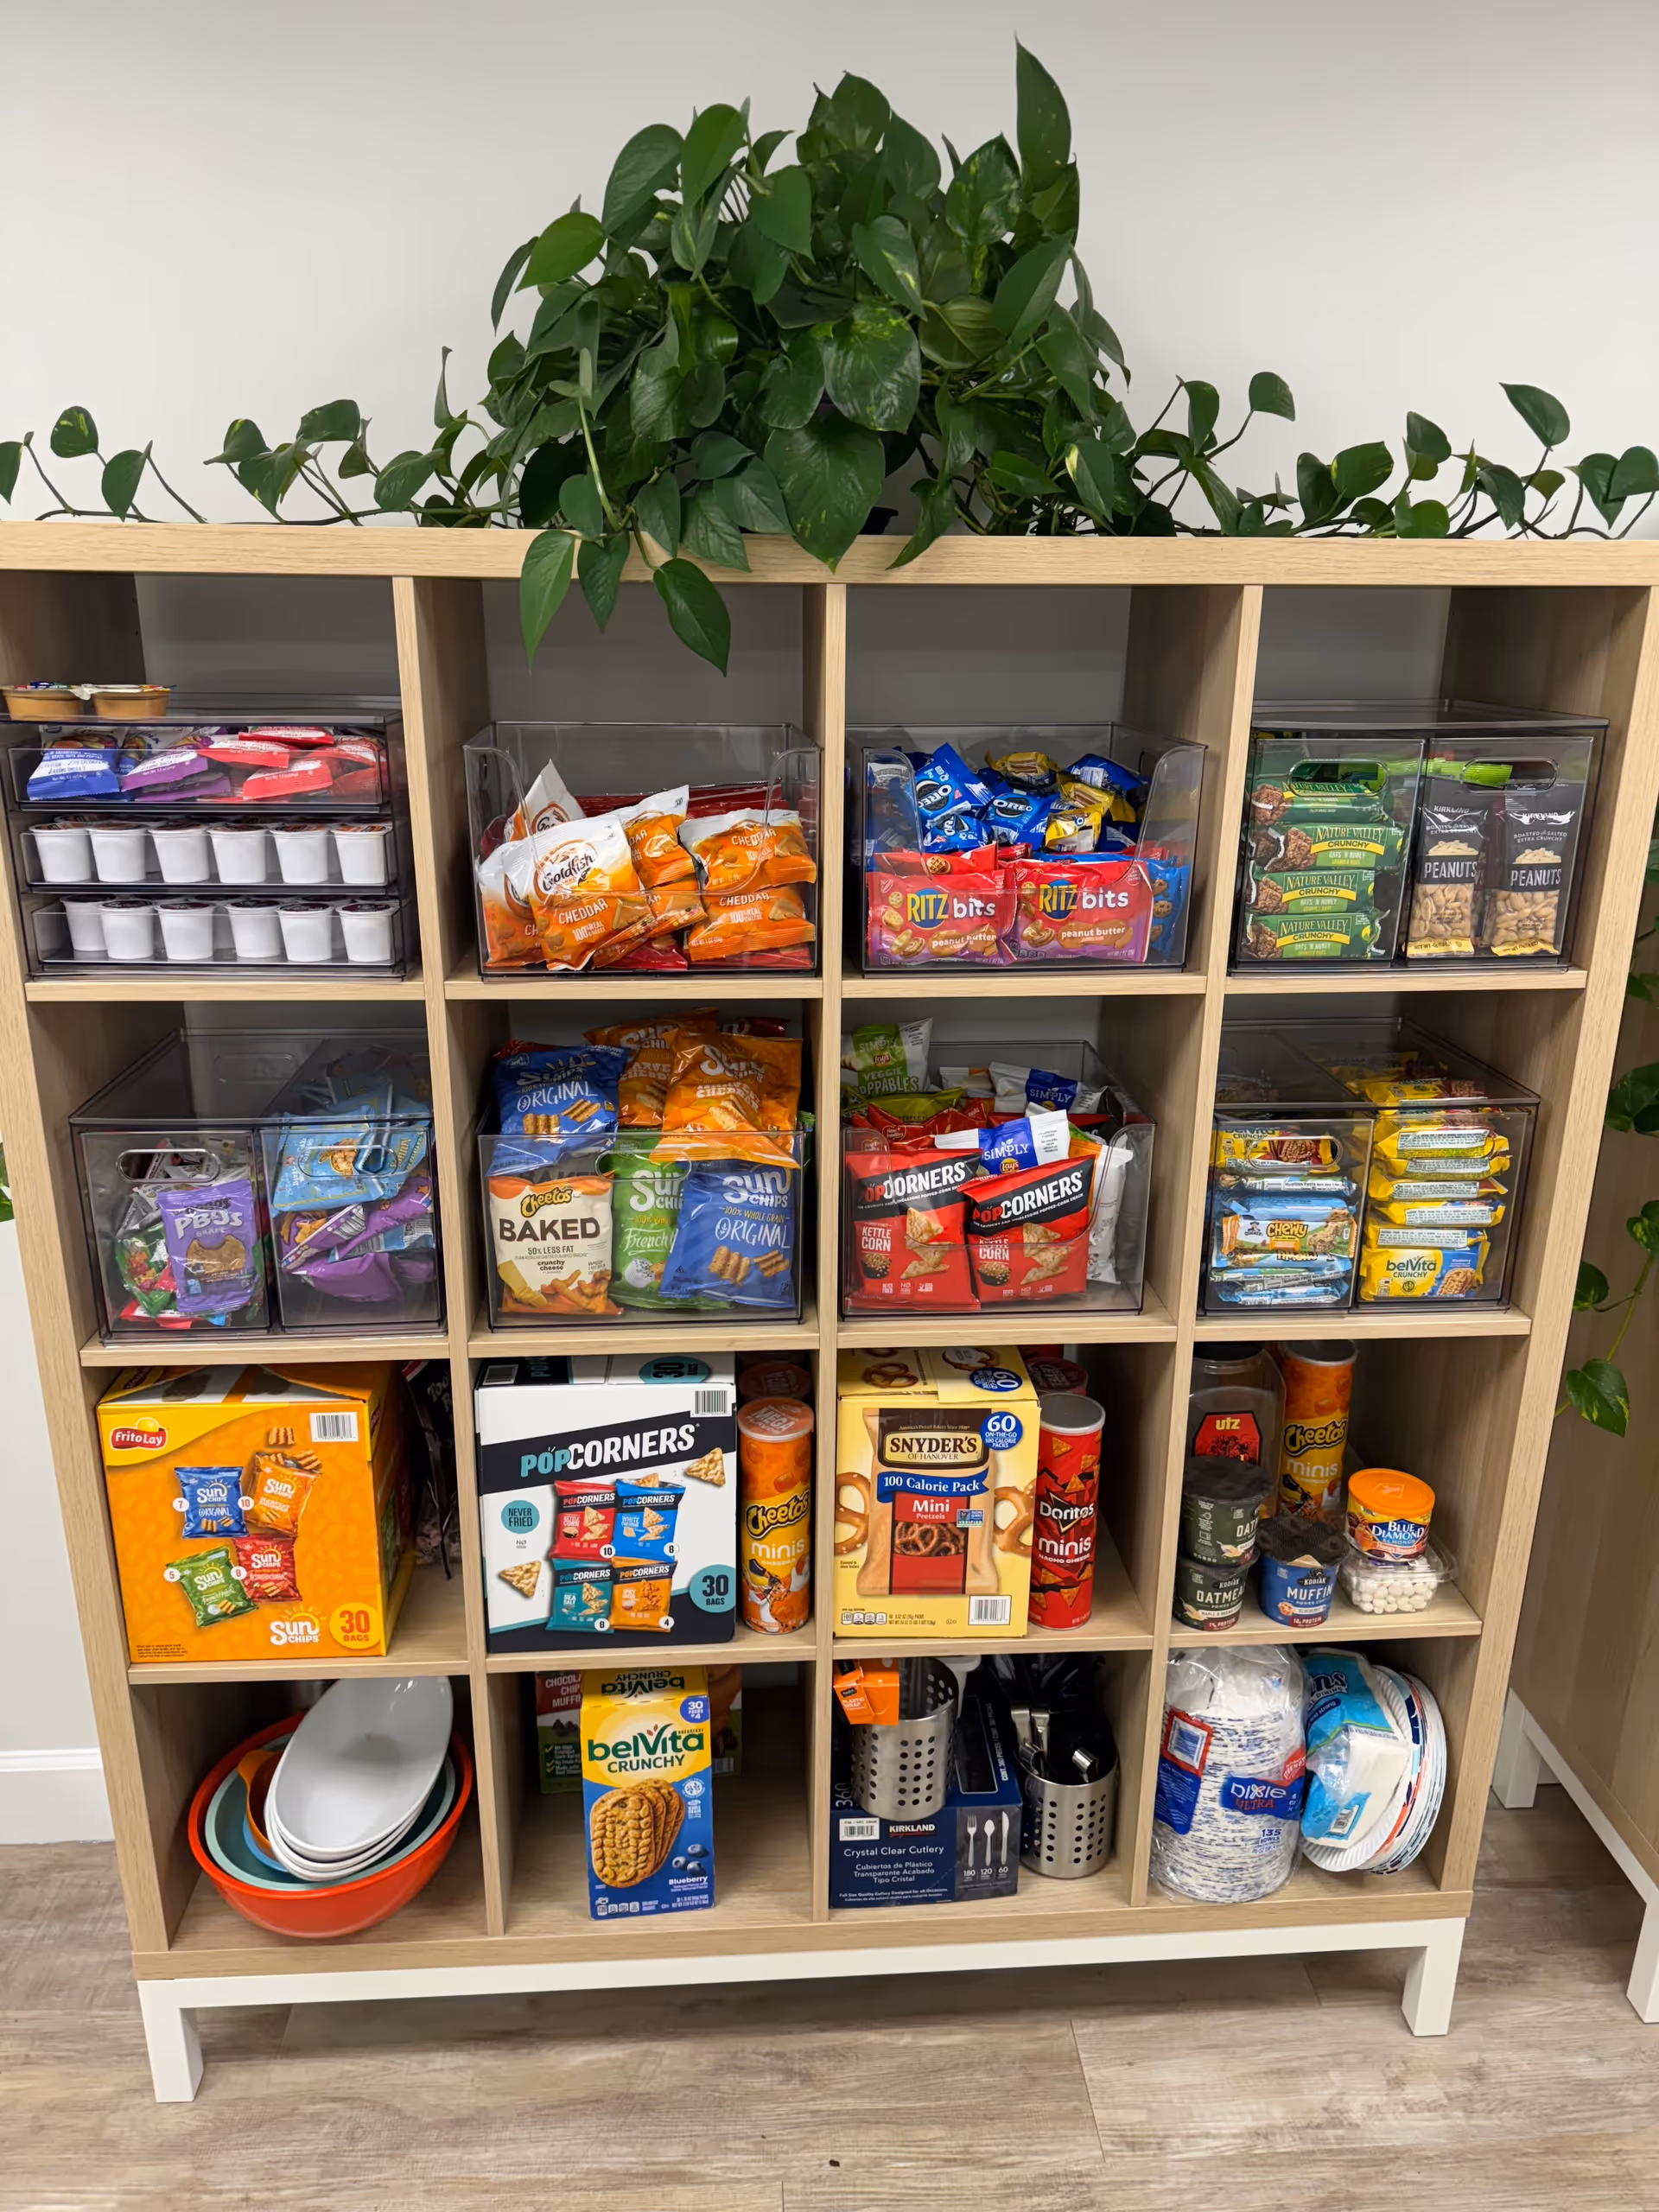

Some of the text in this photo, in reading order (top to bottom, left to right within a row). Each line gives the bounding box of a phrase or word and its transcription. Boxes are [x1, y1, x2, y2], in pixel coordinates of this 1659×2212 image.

[993, 799, 1033, 812] OREO
[731, 828, 777, 847] CHEDDAR
[1316, 827, 1383, 842] NATURE VALLEY
[543, 853, 594, 892] Goldfish
[1424, 861, 1478, 879] PEANUTS
[1510, 868, 1562, 887] PEANUTS
[1287, 874, 1357, 891] NATURE VALLEY
[719, 892, 770, 906] CHEDDAR
[1039, 884, 1129, 913] RITZ bits
[1299, 887, 1340, 896] CRUNCHY
[558, 898, 608, 925] CHEDDAR
[907, 893, 996, 923] RITZ bits
[1061, 926, 1126, 939] peanut butter
[1281, 919, 1349, 936] NATURE VALLEY
[1293, 931, 1334, 941] CRUNCHY
[931, 933, 997, 950] peanut butter
[863, 1067, 904, 1081] VEGGIE
[517, 1081, 599, 1113] ORIGINAL
[1030, 1087, 1072, 1103] SIMPLY
[983, 1142, 1029, 1160] SIMPLY
[722, 1169, 791, 1204] Sun
[520, 1186, 574, 1217] Cheetos
[749, 1194, 788, 1208] CHIPS
[1039, 1192, 1084, 1213] POPPED-CORN SNACK
[725, 1206, 785, 1223] 100% WHOLE GRAIN
[195, 1227, 227, 1237] GRAPE
[499, 1217, 601, 1242] BAKED
[715, 1217, 791, 1249] ORIGINAL
[862, 1227, 892, 1240] KETTLE
[623, 1228, 669, 1252] French
[861, 1237, 891, 1251] CORN
[979, 1248, 1009, 1261] CORN
[1386, 1255, 1437, 1272] belVita
[987, 1414, 1016, 1432] 60
[890, 1436, 978, 1453] SNYDER'S
[1284, 1418, 1348, 1456] Cheetos
[520, 1423, 696, 1478] POPCORNERS
[1287, 1459, 1338, 1478] minis
[264, 1478, 296, 1495] Sun
[884, 1476, 980, 1492] 100 Calorie Pack
[197, 1486, 228, 1503] Sun
[241, 1498, 251, 1508] 10
[563, 1493, 615, 1505] POPCORNERS
[623, 1495, 676, 1505] POPCORNERS
[199, 1507, 232, 1517] ORIGINAL
[508, 1508, 532, 1516] NEVER
[747, 1489, 810, 1539] Cheetos
[912, 1499, 950, 1512] Mini
[1039, 1500, 1095, 1521] Doritos
[508, 1516, 533, 1528] FRIED
[1388, 1521, 1415, 1532] BLUE
[1371, 1525, 1425, 1540] DIAMOND
[751, 1539, 805, 1559] minis
[1038, 1536, 1091, 1555] minis
[1376, 1542, 1397, 1553] Honey
[251, 1553, 282, 1569] Sun
[560, 1569, 611, 1581] POPCORNERS
[620, 1566, 670, 1578] POPCORNERS
[194, 1571, 224, 1592] Sun
[702, 1574, 729, 1597] 30
[1218, 1578, 1240, 1588] KODIAK
[1303, 1577, 1326, 1586] KODIAK
[1287, 1584, 1334, 1601] MUFFIN
[270, 1614, 321, 1645] Sun
[340, 1610, 371, 1634] 30
[288, 1634, 319, 1644] CHIPS
[615, 1670, 671, 1681] CRUNCHY
[561, 1684, 581, 1695] CHIP
[601, 1676, 685, 1699] belVita
[688, 1700, 704, 1710] 30
[1319, 1700, 1337, 1714] strong
[588, 1723, 704, 1762] belVita
[607, 1754, 685, 1774] CRUNCHY
[835, 1783, 853, 1808] 360
[1236, 1798, 1274, 1811] ULTRA
[889, 1823, 936, 1833] KIRKLAND
[1261, 1828, 1281, 1838] 135
[843, 1846, 944, 1859] Crystal Clear Cutlery
[669, 1876, 709, 1885] Blueberry
